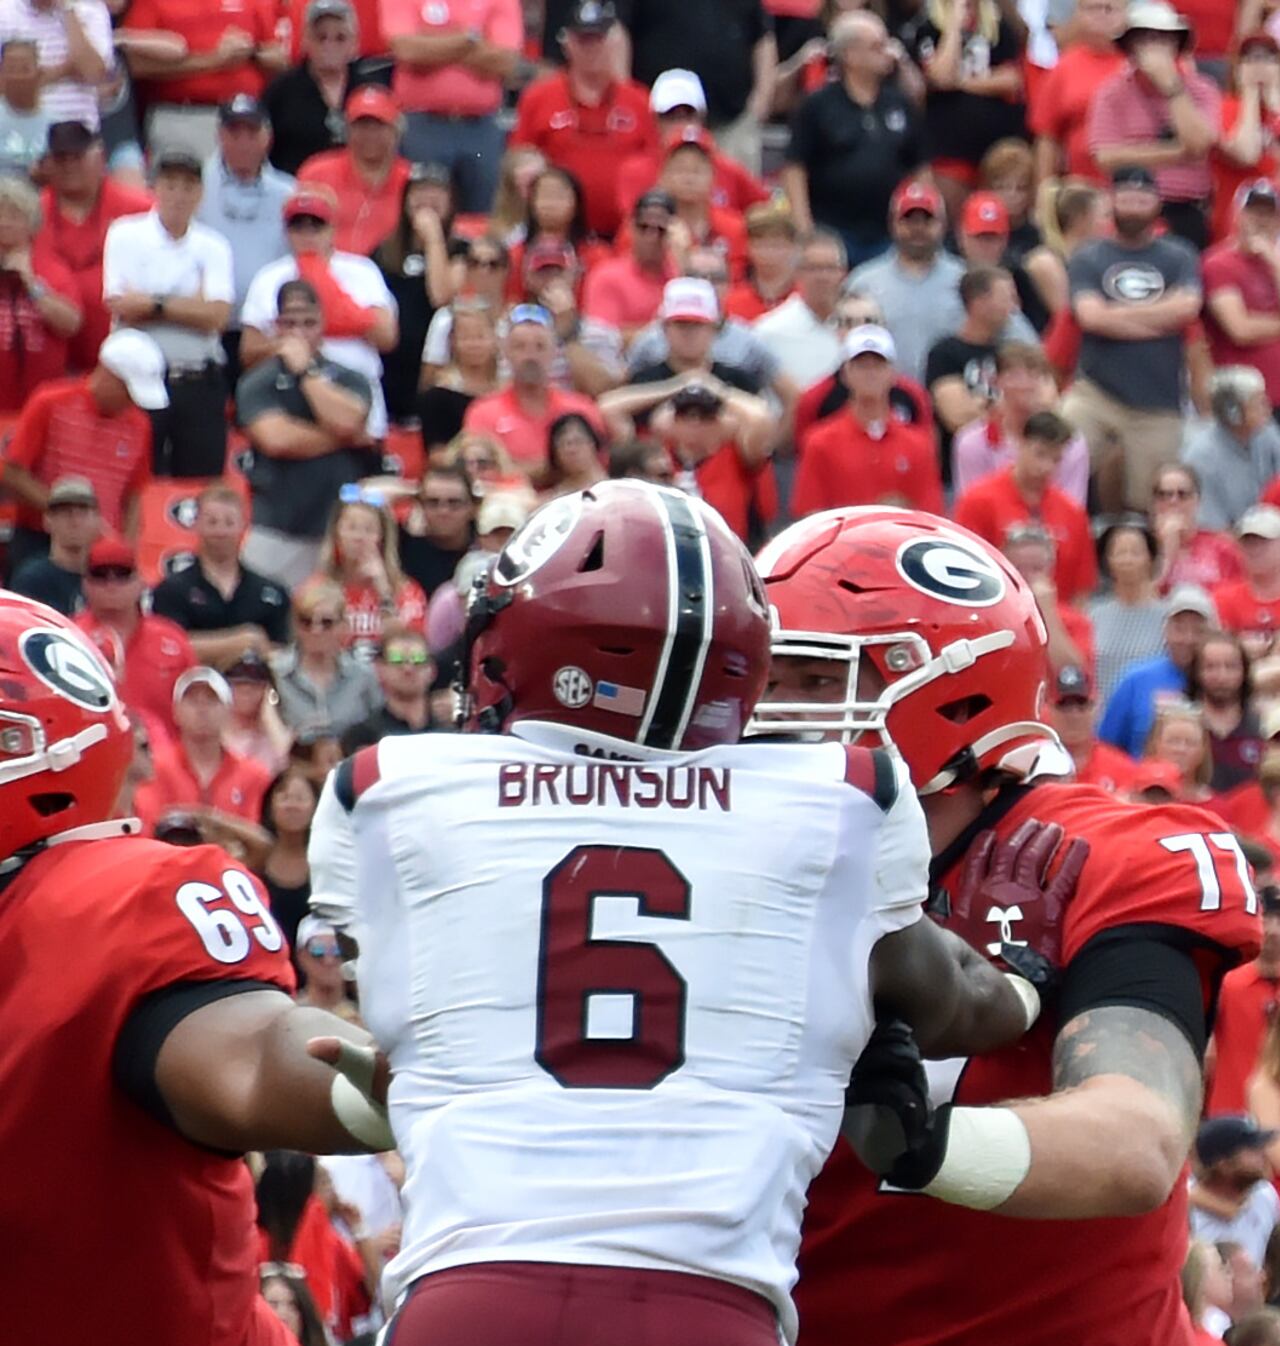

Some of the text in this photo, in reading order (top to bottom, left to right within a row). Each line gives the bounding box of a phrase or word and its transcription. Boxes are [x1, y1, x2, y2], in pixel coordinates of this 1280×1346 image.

[553, 666, 593, 709] SEC
[498, 763, 732, 812] BRUNSON
[1159, 832, 1258, 915] 77
[176, 869, 282, 964] 69
[535, 845, 692, 1089] 6
